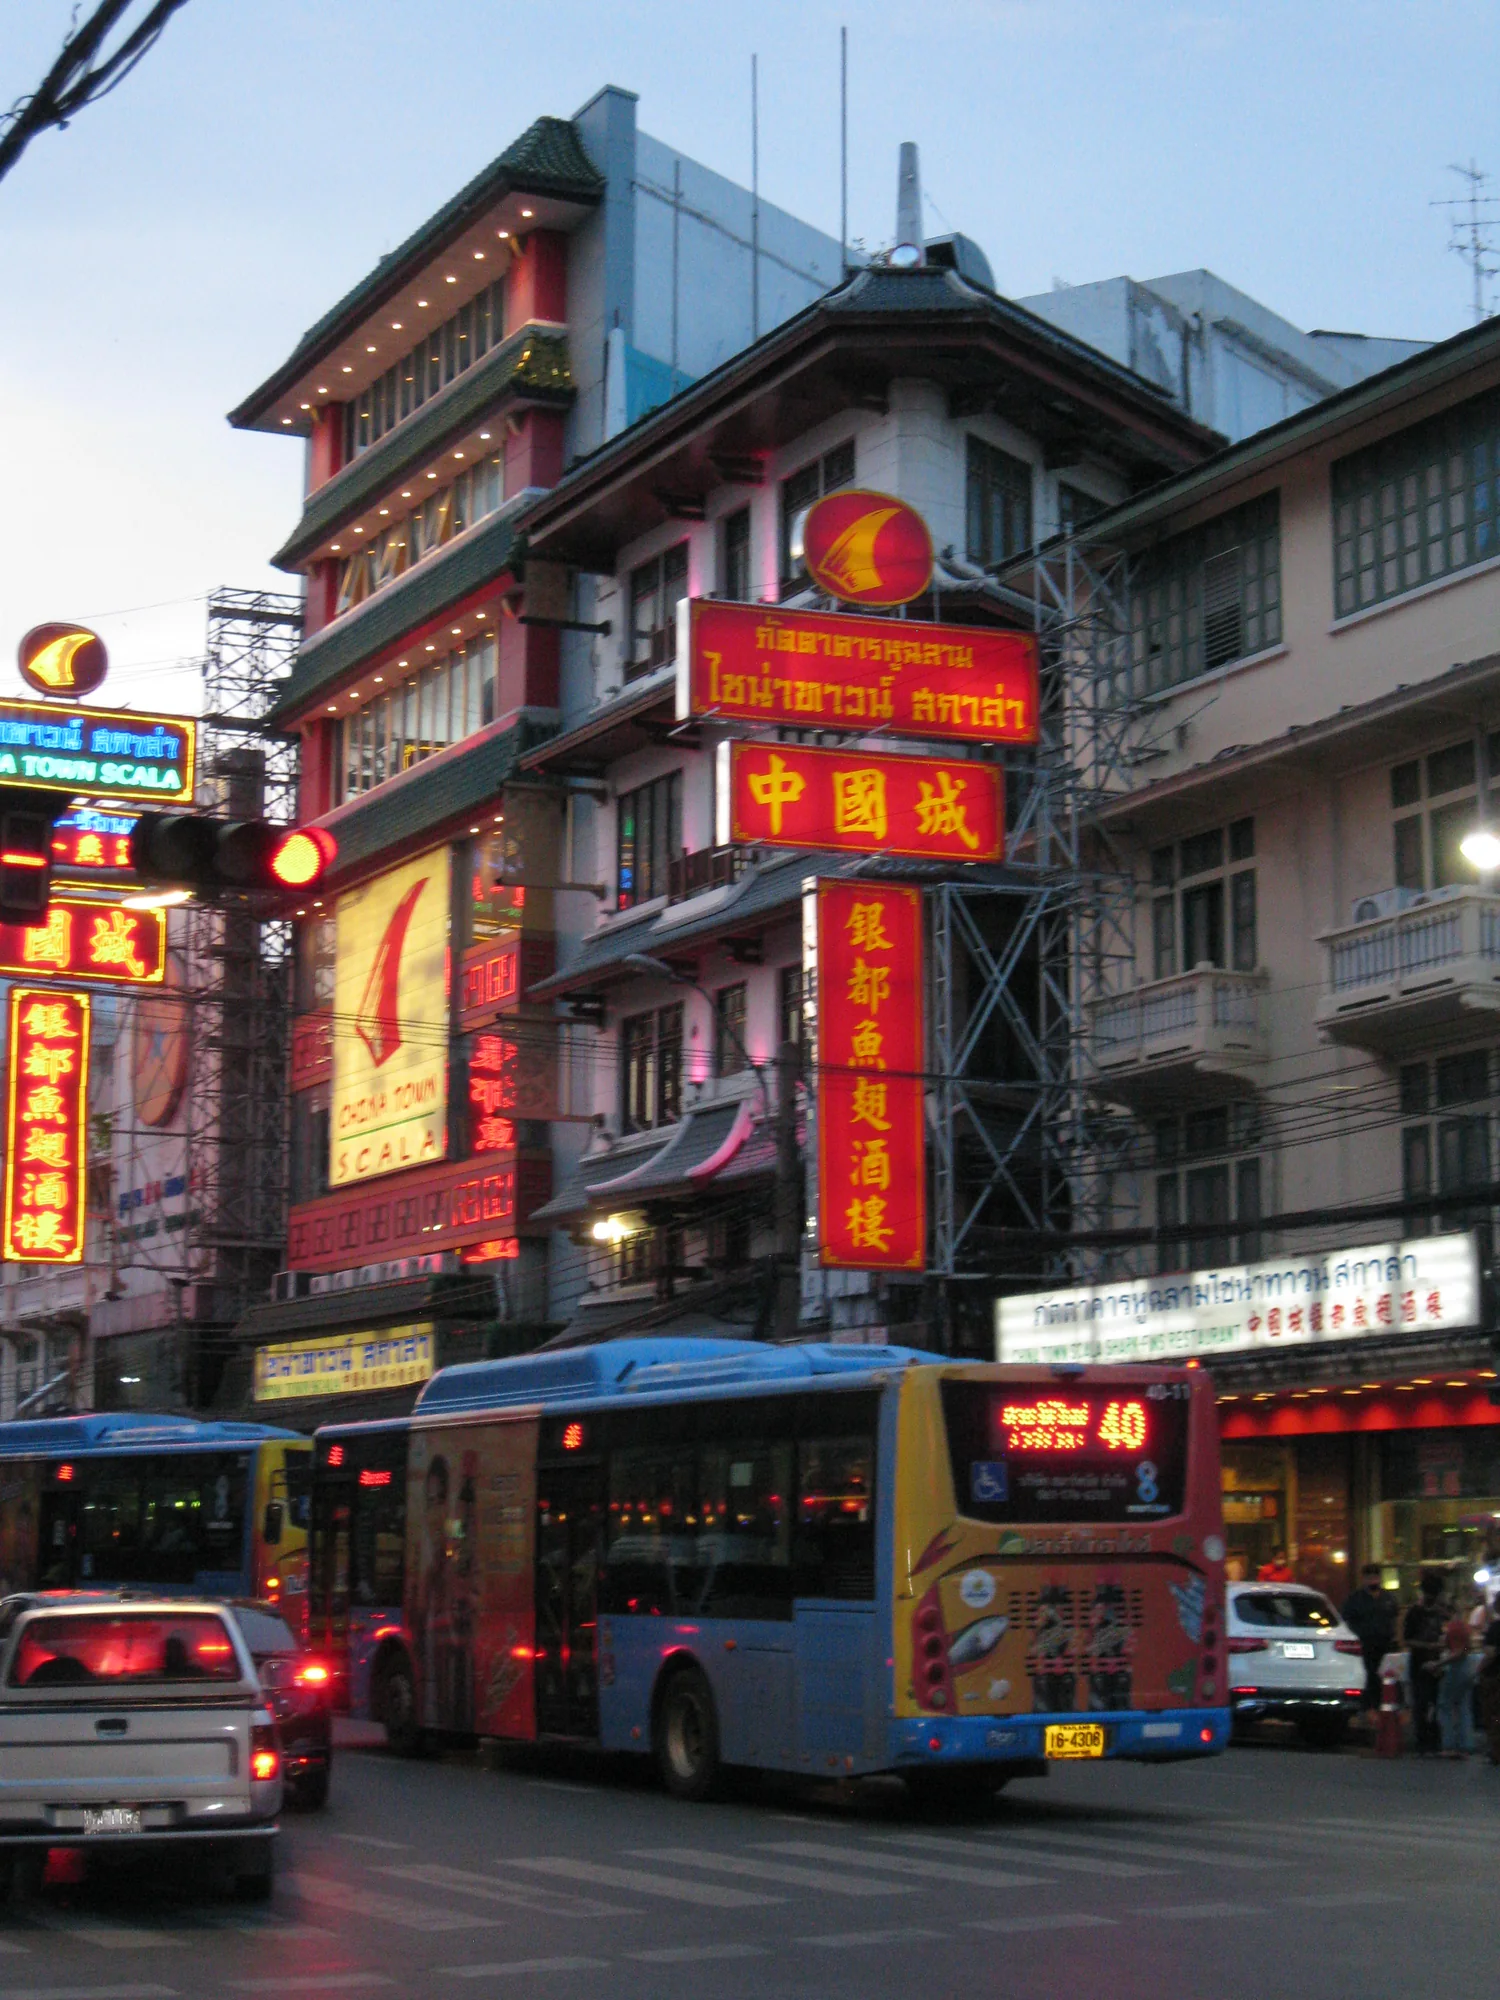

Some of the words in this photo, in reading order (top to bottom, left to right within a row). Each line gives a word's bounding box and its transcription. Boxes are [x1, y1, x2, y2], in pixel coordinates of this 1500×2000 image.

[705, 651, 895, 719] ไชน่าทาวน์
[911, 683, 1026, 730] สกาล่า
[22, 755, 97, 782] TOWN
[100, 762, 182, 790] SCALA
[748, 754, 980, 850] 中國城
[394, 1074, 437, 1113] TOWN
[845, 901, 896, 1253] 銀都魚翅酒樓
[14, 1002, 79, 1254] 銀都魚翅酒樓
[336, 1129, 437, 1180] SCALA
[1098, 1402, 1147, 1449] 40
